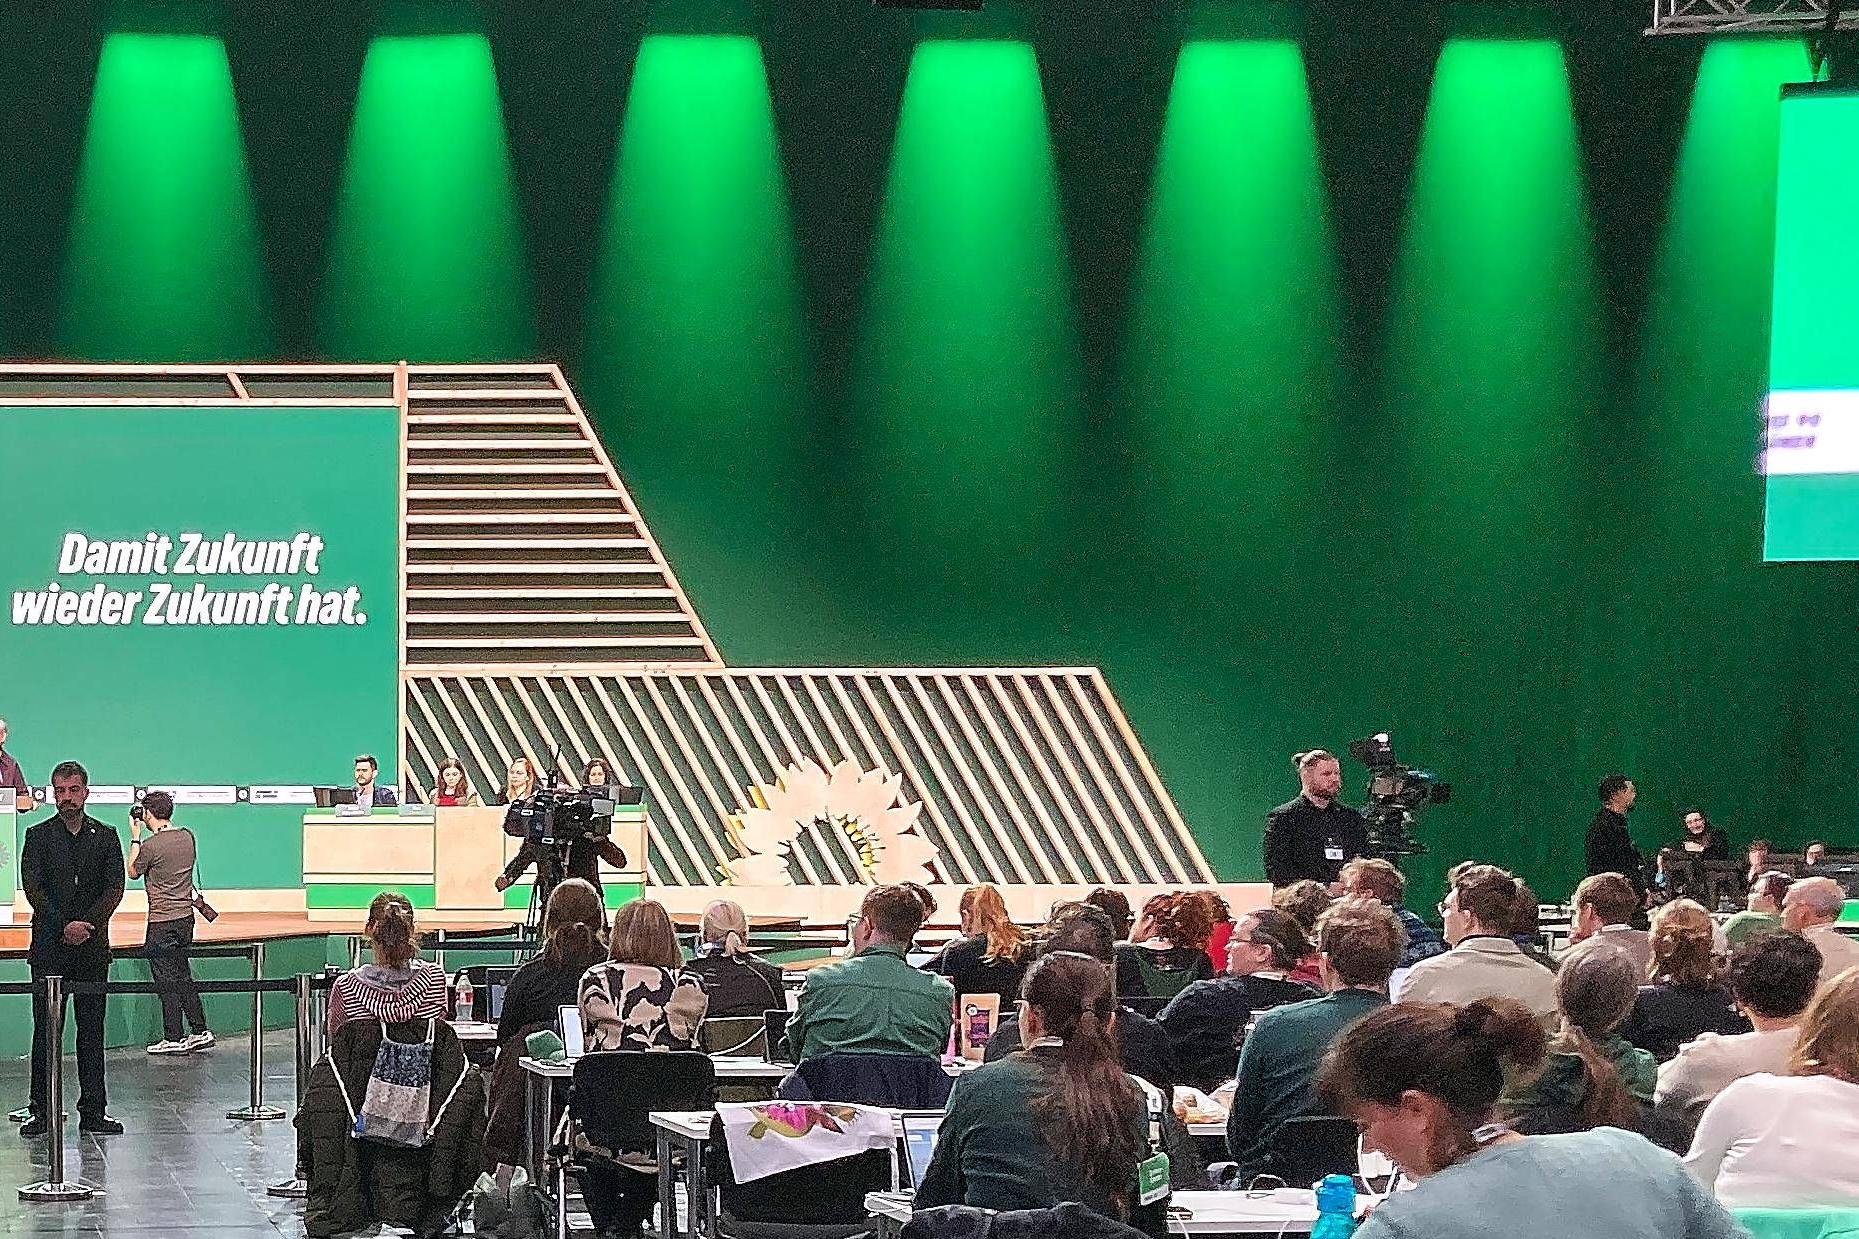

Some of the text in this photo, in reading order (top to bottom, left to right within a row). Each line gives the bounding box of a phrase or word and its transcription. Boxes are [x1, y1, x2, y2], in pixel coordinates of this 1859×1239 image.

[57, 531, 324, 574] Damit Zukunft
[11, 582, 367, 625] wieder Zukunft hat.
